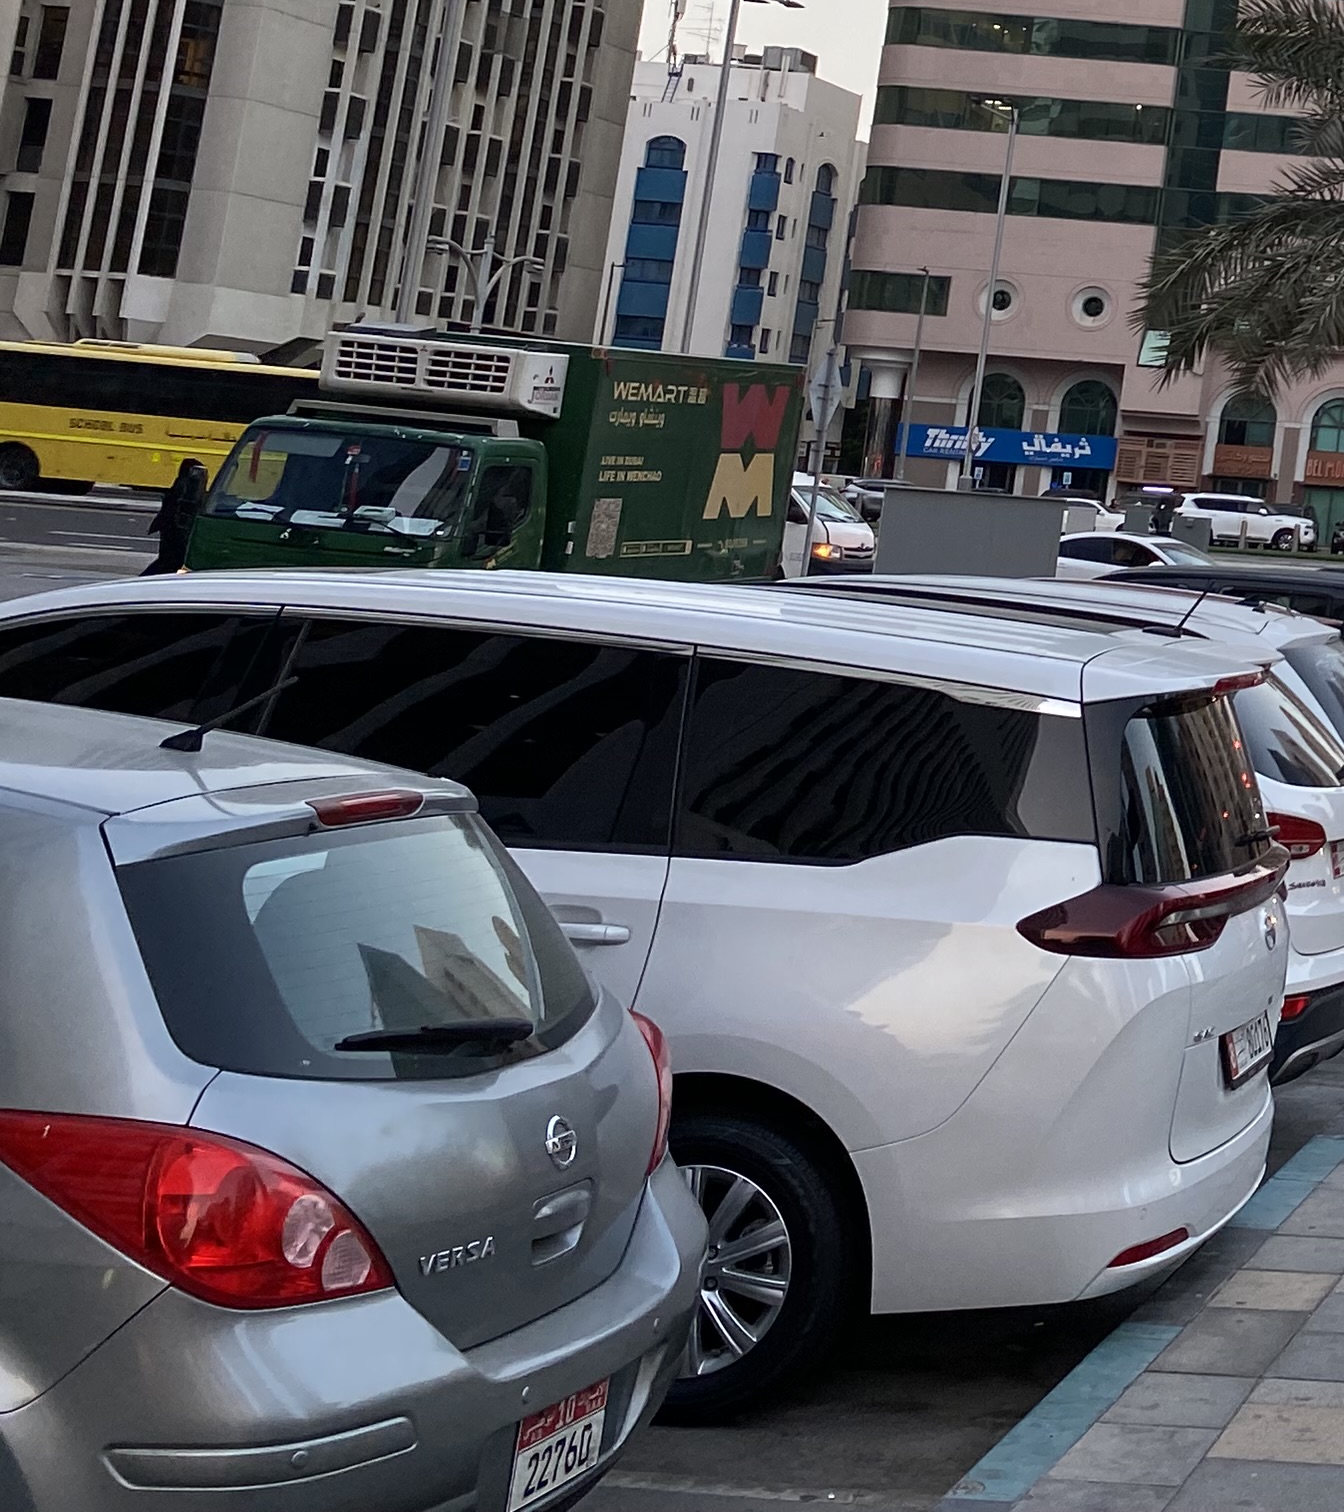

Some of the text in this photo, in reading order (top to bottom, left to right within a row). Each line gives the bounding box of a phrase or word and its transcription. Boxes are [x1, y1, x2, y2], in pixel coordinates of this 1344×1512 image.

[613, 380, 689, 404] WEMART
[119, 422, 144, 435] BUS
[1306, 458, 1323, 477] BEL
[418, 1235, 497, 1277] VERSA
[521, 1422, 593, 1500] 22760
